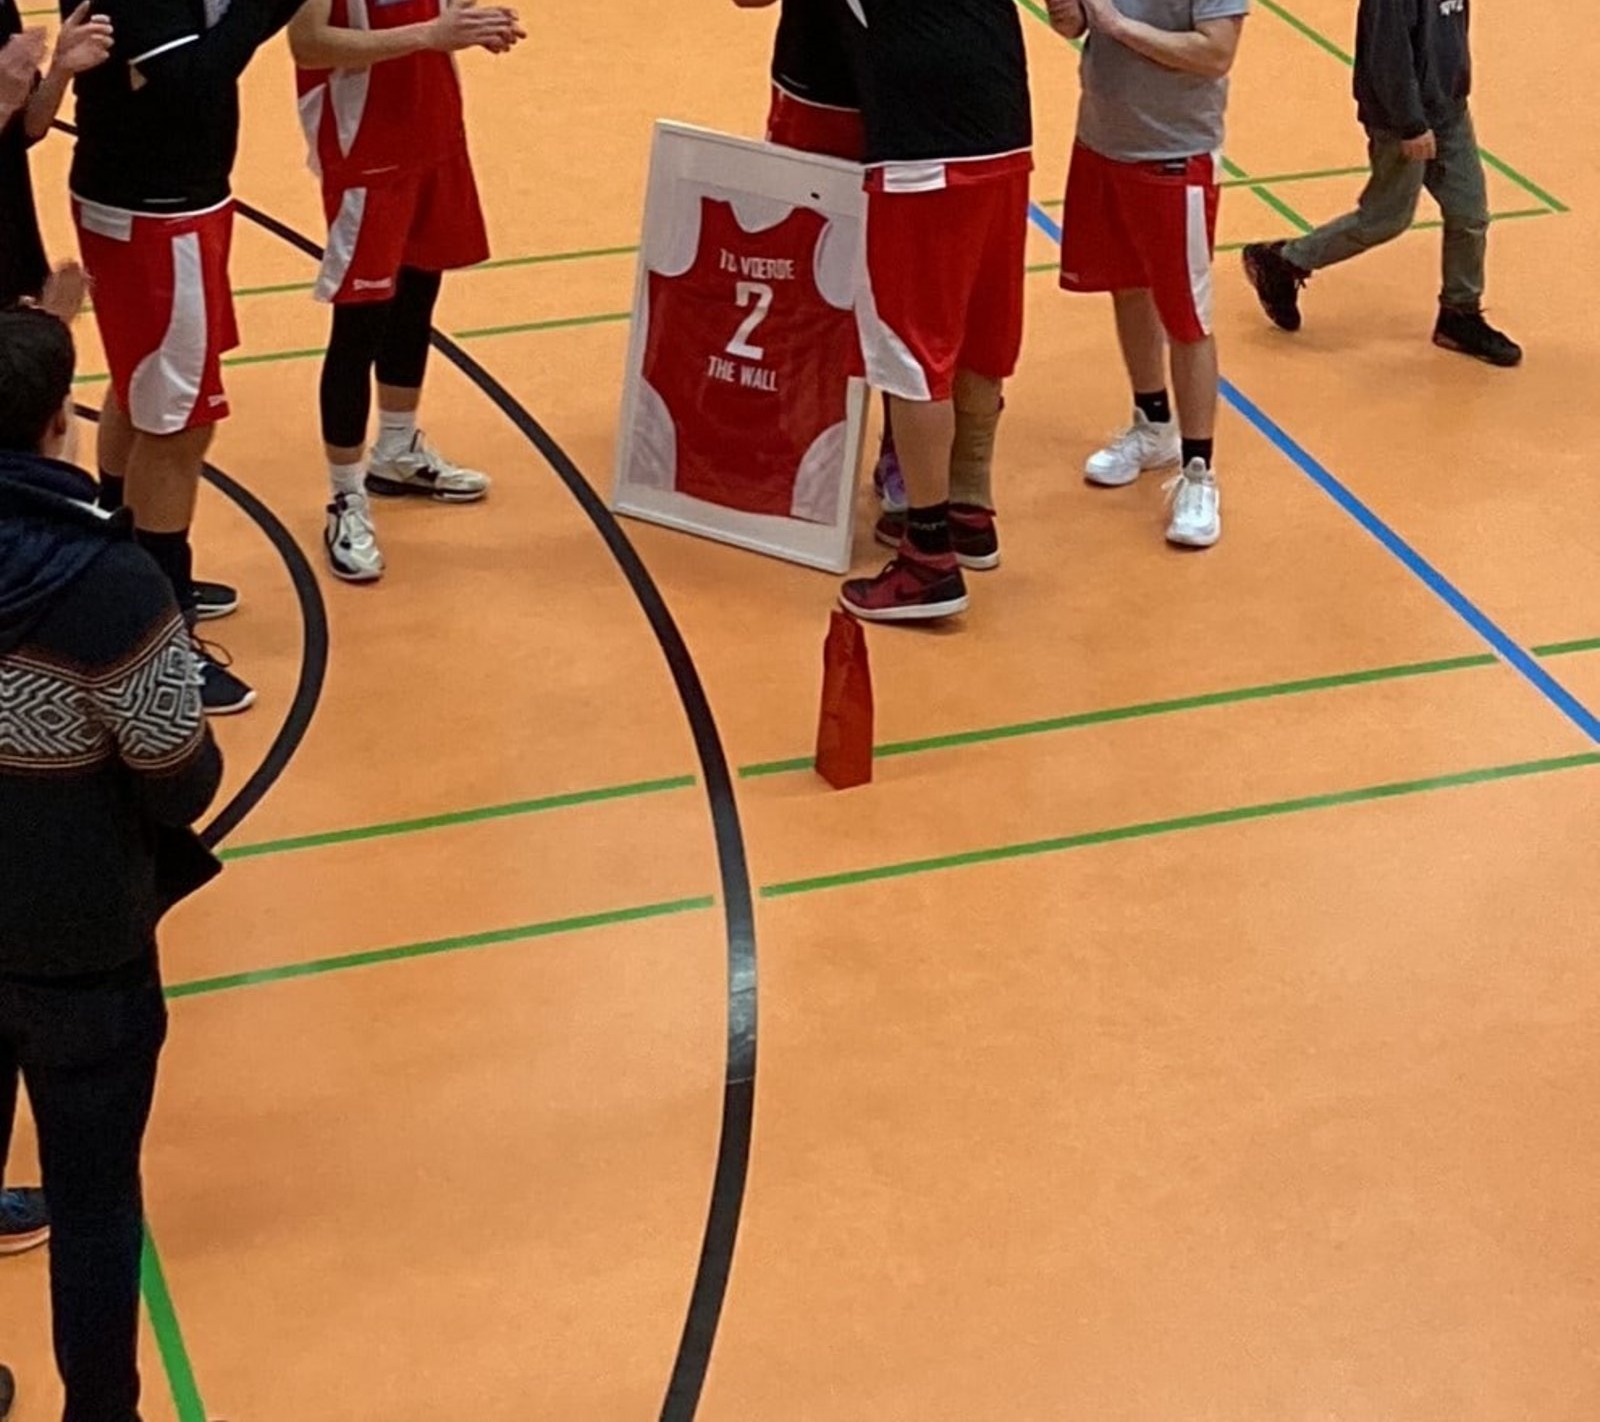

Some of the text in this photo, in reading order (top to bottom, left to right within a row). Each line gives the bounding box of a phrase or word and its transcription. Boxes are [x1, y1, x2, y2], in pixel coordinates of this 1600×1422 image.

[725, 281, 774, 360] 2
[707, 355, 778, 391] THE WALL
